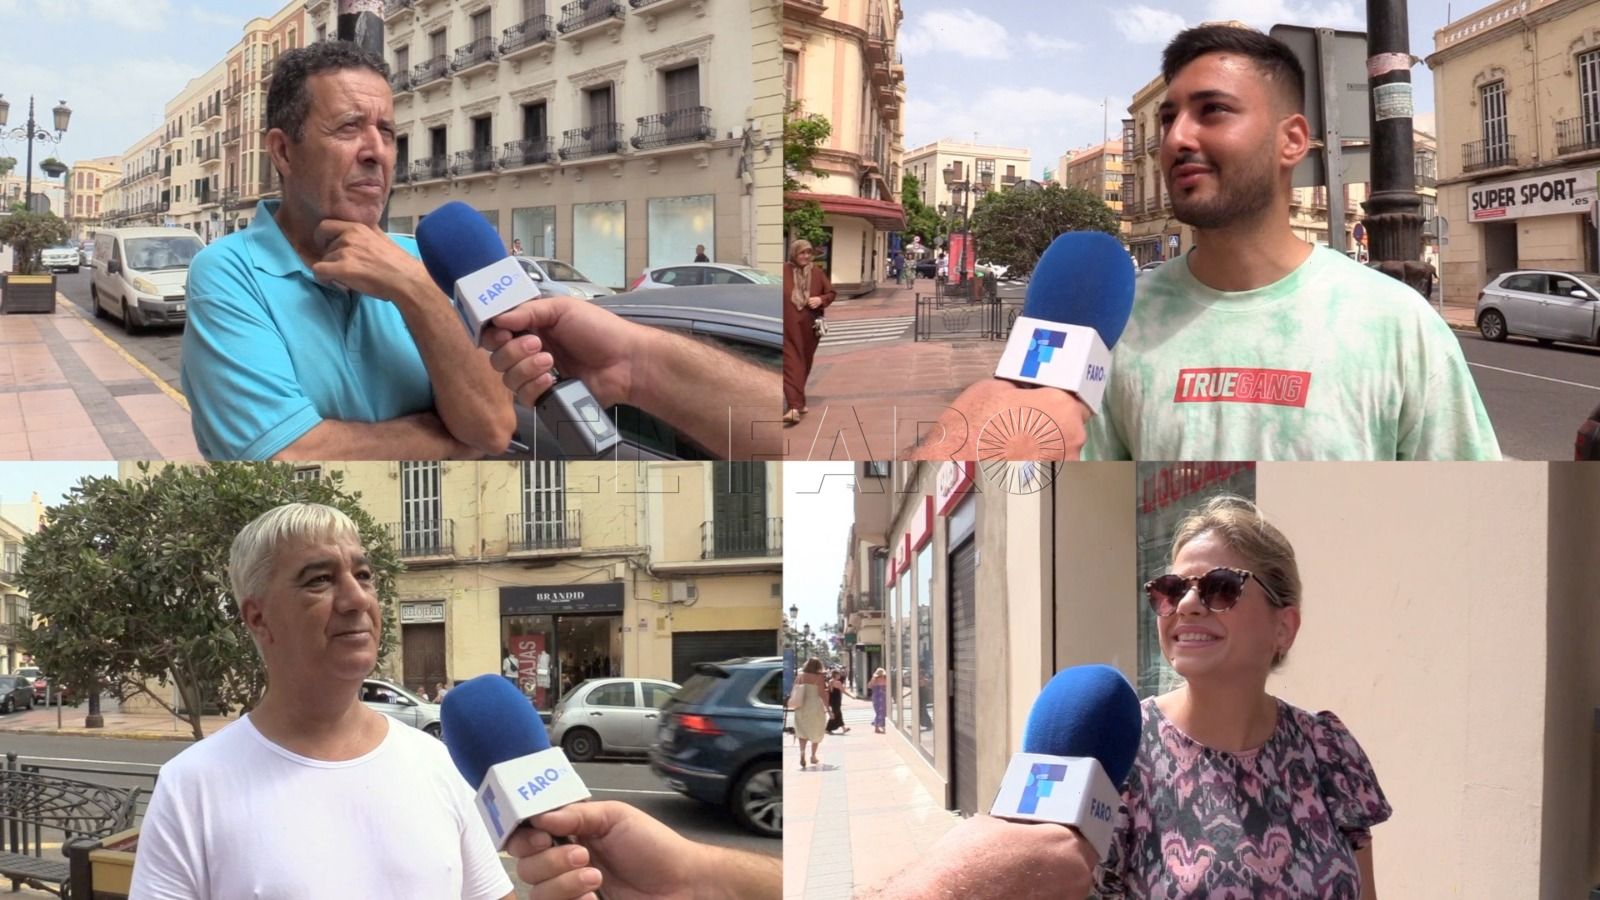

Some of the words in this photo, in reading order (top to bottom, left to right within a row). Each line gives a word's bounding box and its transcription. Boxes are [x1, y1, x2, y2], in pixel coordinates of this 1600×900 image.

[1471, 186, 1516, 210] SUPER
[1520, 178, 1577, 205] SPORT
[1571, 196, 1589, 206] .es
[478, 275, 513, 305] FARO
[1086, 364, 1104, 381] FARO
[536, 591, 585, 601] BRANDID
[518, 768, 559, 801] FARO
[1090, 798, 1112, 821] FARO
